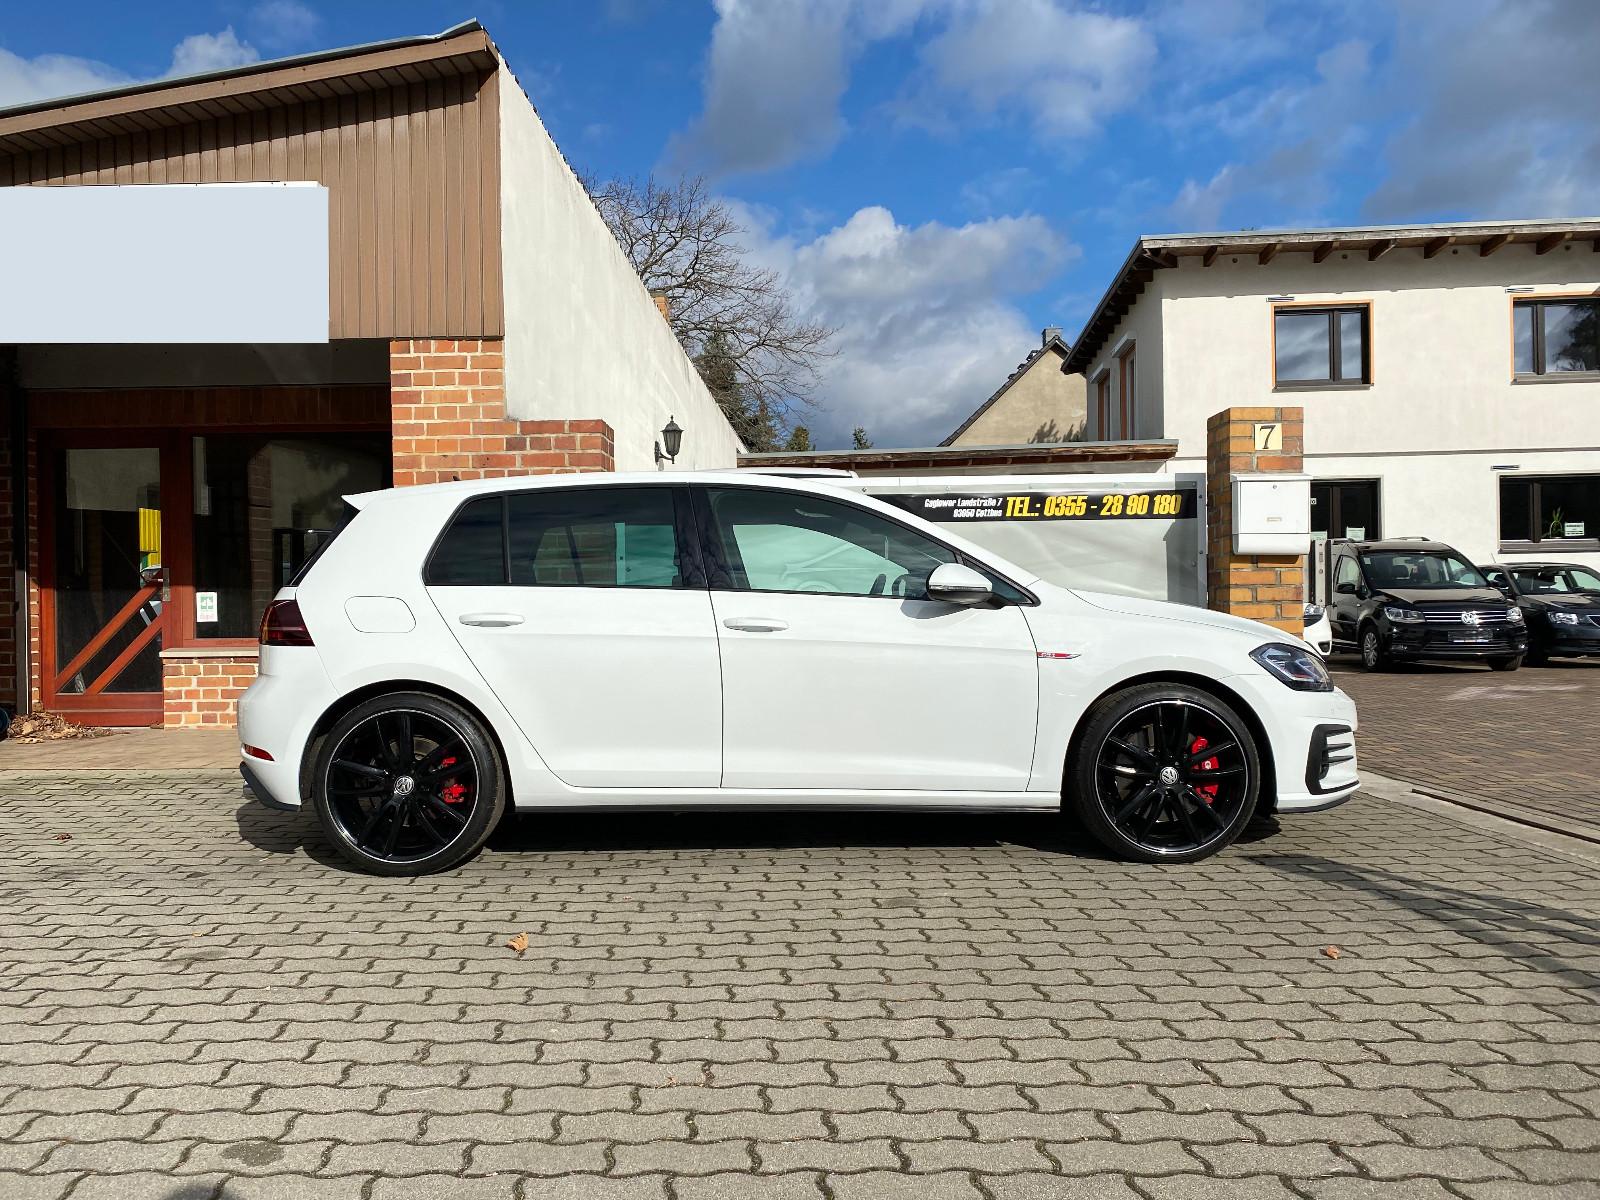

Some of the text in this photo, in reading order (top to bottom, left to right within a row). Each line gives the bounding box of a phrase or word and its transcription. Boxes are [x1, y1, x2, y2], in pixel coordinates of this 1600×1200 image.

[1259, 424, 1277, 450] 7
[957, 497, 996, 507] Landstraße
[997, 497, 1003, 507] 7
[1005, 496, 1041, 517] TEL.:
[1043, 495, 1088, 517] 0355
[1100, 494, 1124, 516] 28
[1126, 494, 1150, 515] 90
[1153, 494, 1182, 515] 180
[976, 508, 1002, 518] Cottbus
